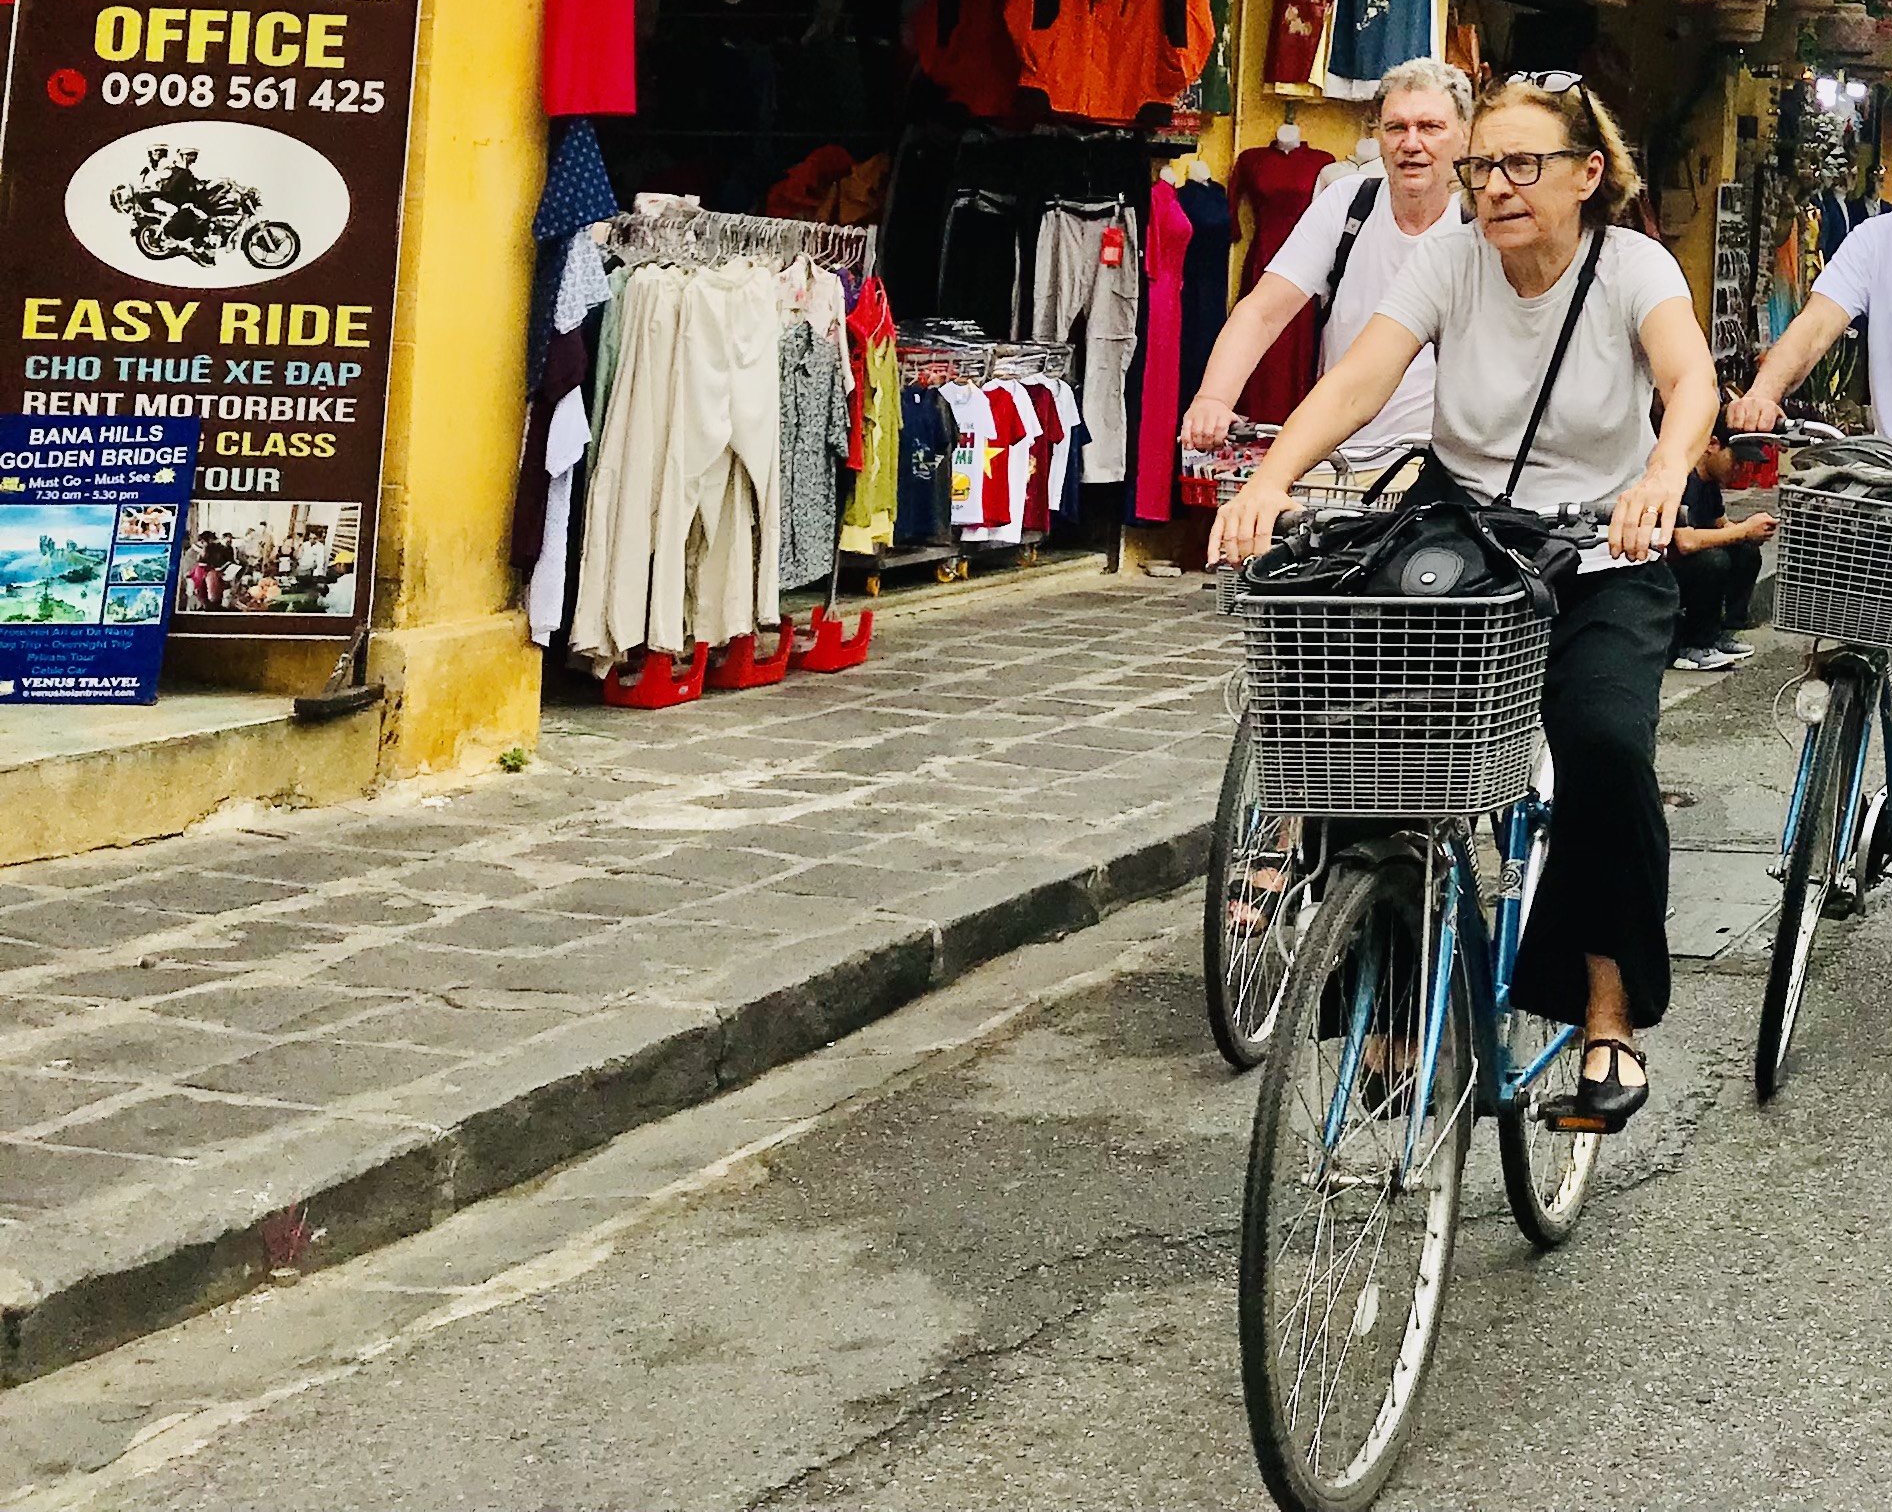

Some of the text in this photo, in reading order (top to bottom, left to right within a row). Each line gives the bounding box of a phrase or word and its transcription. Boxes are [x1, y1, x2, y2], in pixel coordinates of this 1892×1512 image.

[94, 7, 348, 69] OFFICE
[101, 73, 386, 115] 0908 561 425
[22, 298, 374, 349] EASY RIDE
[24, 354, 362, 392] CHO THUÊ XE ĐẠP
[22, 391, 358, 423] RENT MOTORBIKE
[29, 425, 164, 445] BANA HILLS
[216, 432, 336, 458] CLASS
[0, 446, 188, 469] GOLDEN BRIDGE
[28, 476, 60, 489] Must
[62, 475, 82, 487] Go
[94, 473, 125, 485] Must
[128, 471, 150, 483] See
[119, 491, 139, 502] pm
[22, 677, 140, 688] VENUS TRAVEL
